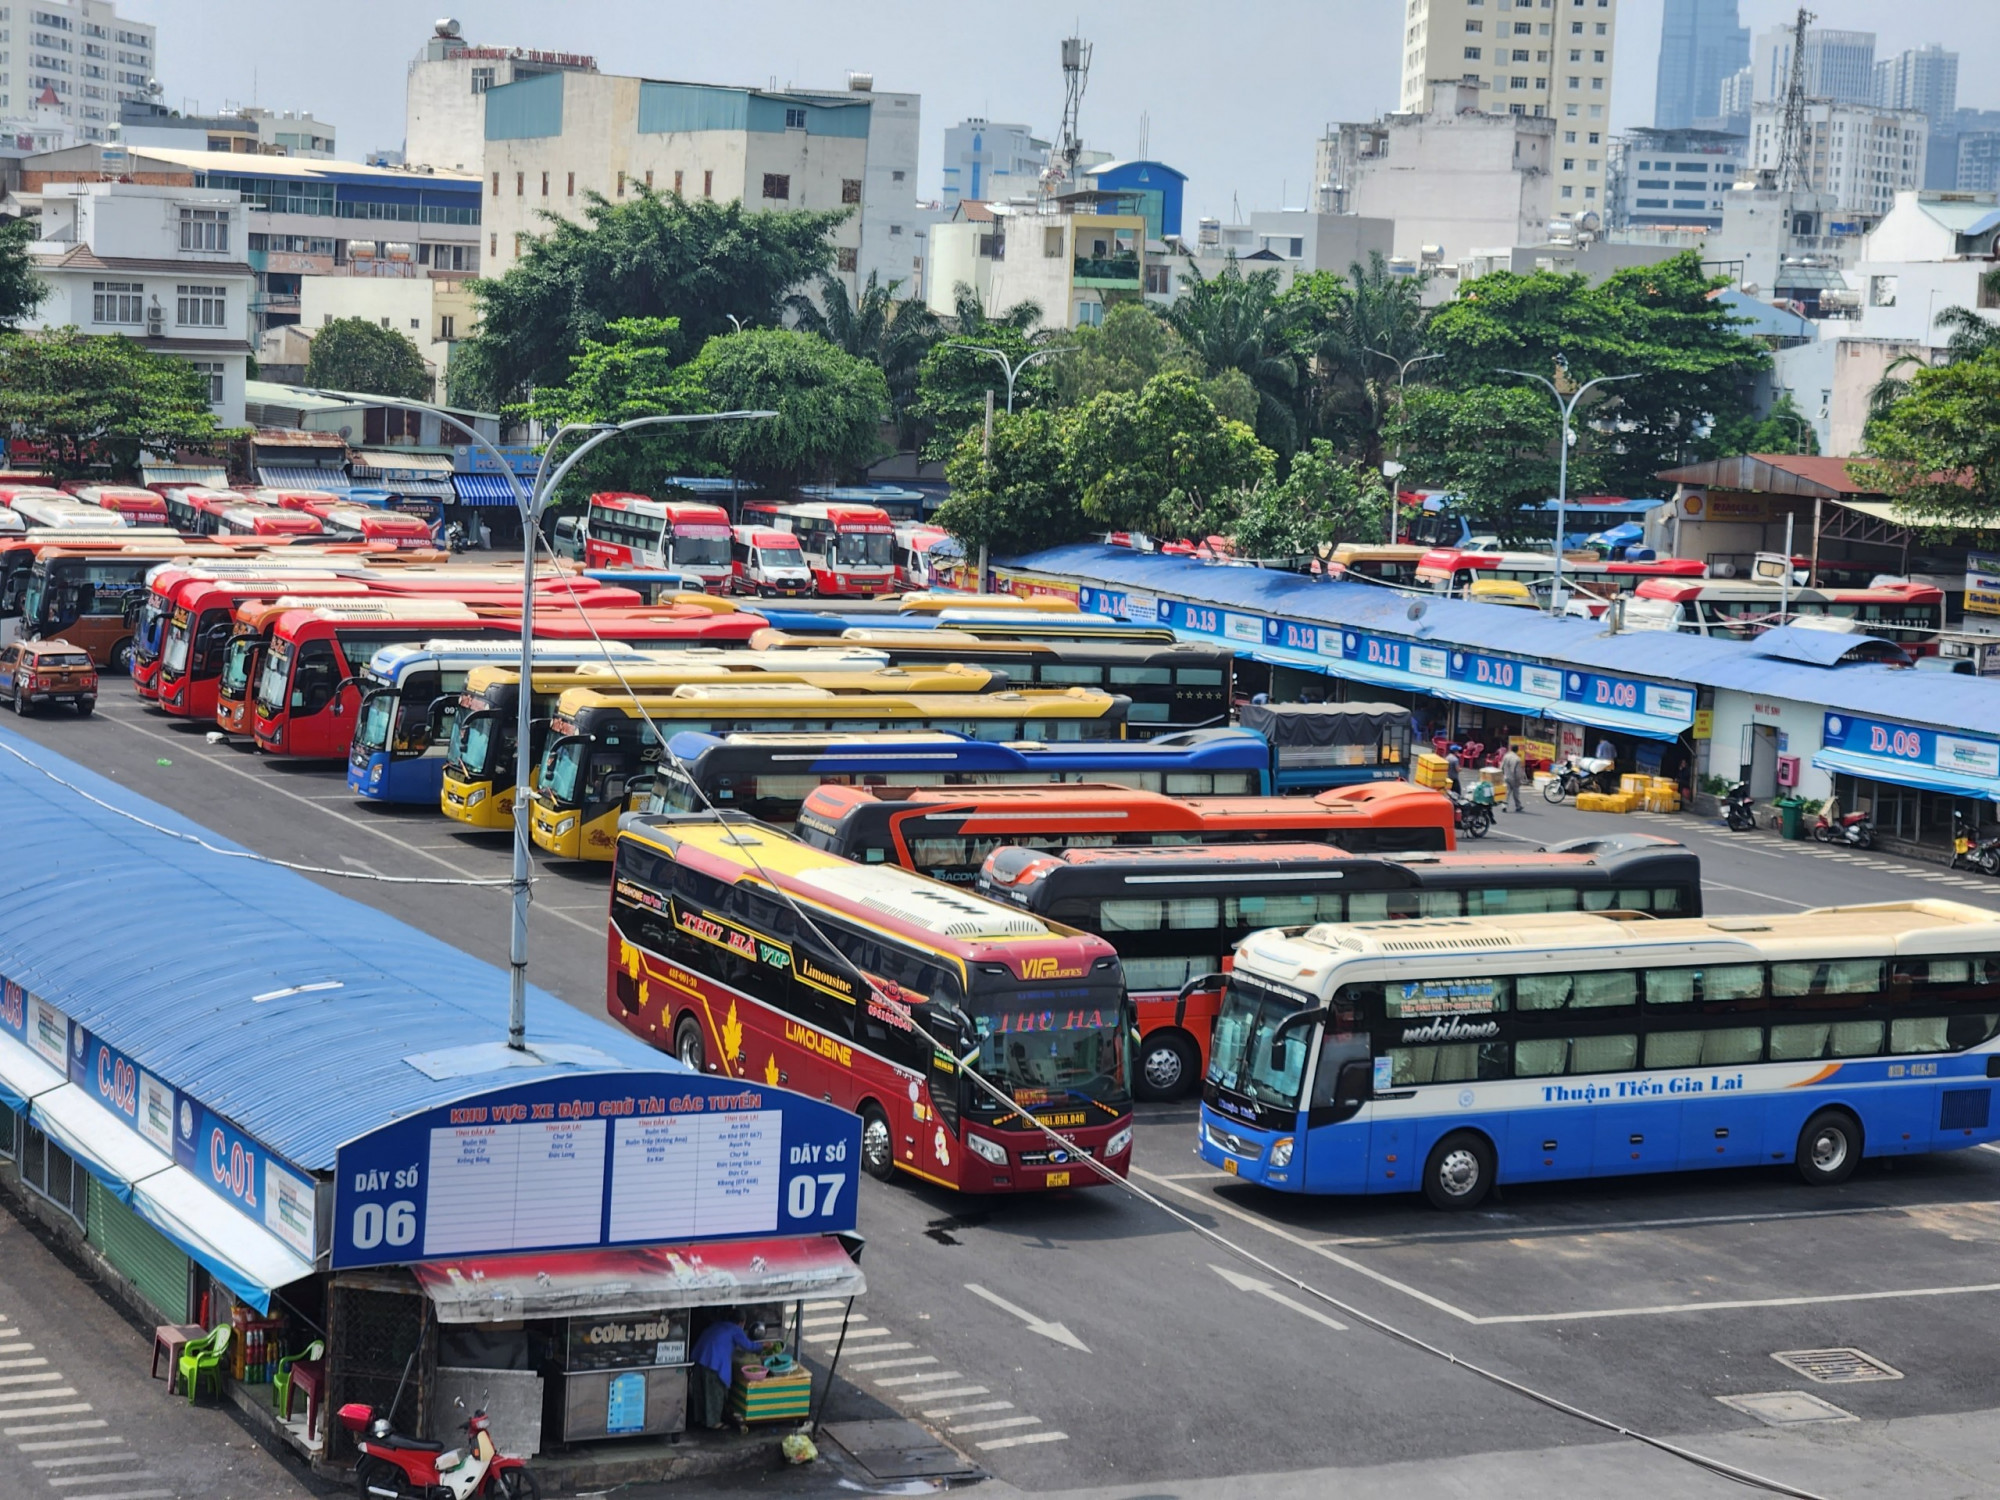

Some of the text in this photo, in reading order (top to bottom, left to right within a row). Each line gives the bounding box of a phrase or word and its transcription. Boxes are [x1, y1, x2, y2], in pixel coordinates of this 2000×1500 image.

[138, 513, 166, 521] SAMCO
[1099, 593, 1126, 616] D.14
[1186, 608, 1216, 632] D.13
[1288, 625, 1315, 649] D.12
[1368, 640, 1401, 666] D.11
[1477, 659, 1513, 687] D.10
[1596, 680, 1636, 708] D.09
[1871, 726, 1921, 758] D.08
[682, 912, 724, 941] THU
[760, 944, 790, 969] VIP
[803, 959, 852, 994] Limousine
[1021, 957, 1058, 979] VIP
[1041, 967, 1082, 979] LIMOUSINES
[0, 980, 22, 1030] .03
[1402, 1015, 1500, 1043] mobihome
[785, 1020, 852, 1068] LIMOUSINE
[98, 1046, 136, 1117] C.02
[1542, 1074, 1743, 1103] Thuận Tiến Gia Lai
[451, 1090, 762, 1123] KHU VỰC XE ĐẬU CHỜ TÀI CÁC TUYẾN
[790, 1138, 847, 1165] DÃY SỐ
[211, 1127, 257, 1208] C.01
[355, 1162, 419, 1192] DÃY SỐ
[788, 1173, 846, 1218] 07
[352, 1200, 416, 1250] 06
